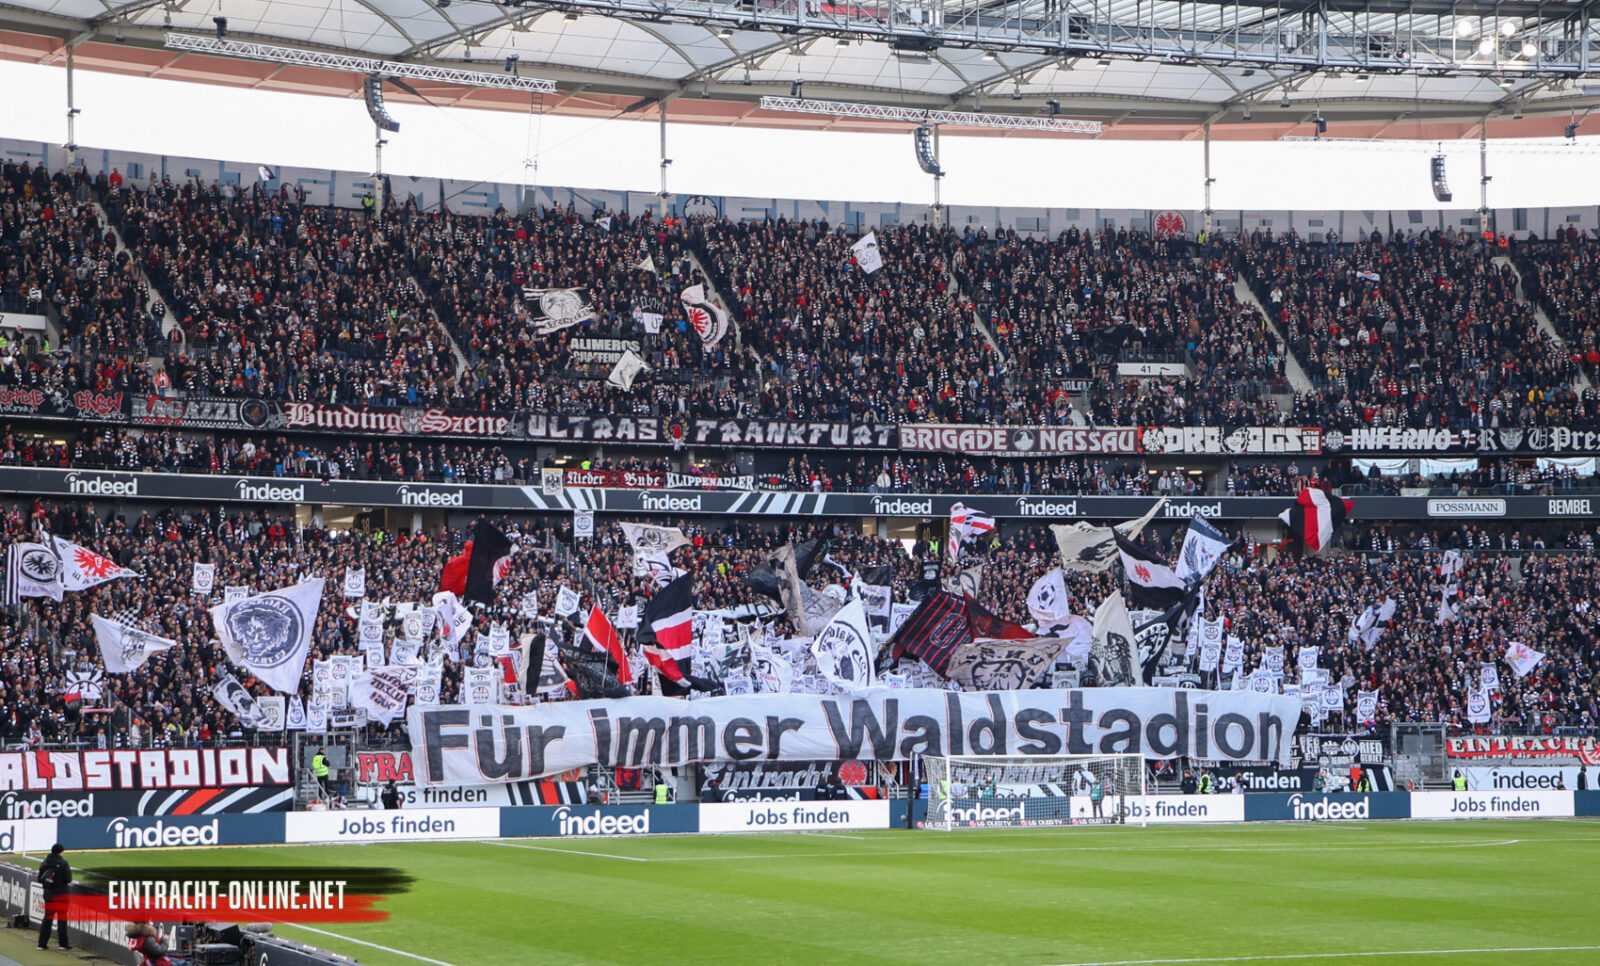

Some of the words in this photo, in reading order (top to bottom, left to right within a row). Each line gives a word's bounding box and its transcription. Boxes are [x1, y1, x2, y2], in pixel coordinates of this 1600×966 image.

[570, 338, 641, 352] ALIMEROS
[132, 400, 239, 420] RAGAZZI
[285, 402, 404, 433] Binding
[420, 408, 510, 434] Szene
[528, 414, 658, 440] ULTRAS
[695, 419, 897, 446] FRANKFURT
[1351, 427, 1453, 451] INFERNO
[901, 428, 1008, 450] BRIGADE
[1040, 430, 1135, 452] NASSAU
[69, 477, 138, 496] indeed
[666, 472, 754, 491] KLIPPENADLER
[239, 484, 305, 502] indeed
[402, 489, 463, 506] indeed
[643, 494, 702, 511] indeed
[875, 498, 932, 515] indeed
[1020, 498, 1077, 516] indeed
[1164, 501, 1222, 517] indeed
[1435, 502, 1499, 513] POSSMANN
[1549, 499, 1593, 515] BEMBEL
[421, 708, 566, 784] Für
[588, 707, 805, 767] immer
[822, 690, 1283, 760] Waldstadion
[1450, 736, 1597, 752] EINTRACHT
[357, 752, 414, 782] FRA
[701, 761, 833, 790] Eintracht
[1243, 771, 1301, 789] finden
[1493, 771, 1563, 789] indeed
[424, 786, 488, 804] finden
[1450, 798, 1487, 813] Jobs
[1490, 796, 1540, 812] finden
[7, 793, 94, 819] indeed
[943, 801, 1025, 821] indeed
[1155, 801, 1207, 816] finden
[1294, 796, 1369, 819] indeed
[338, 816, 385, 835] Jobs
[391, 815, 455, 833] finden
[559, 808, 650, 835] indeed
[747, 809, 787, 826] Jobs
[793, 807, 850, 824] finden
[115, 818, 219, 848] indeed
